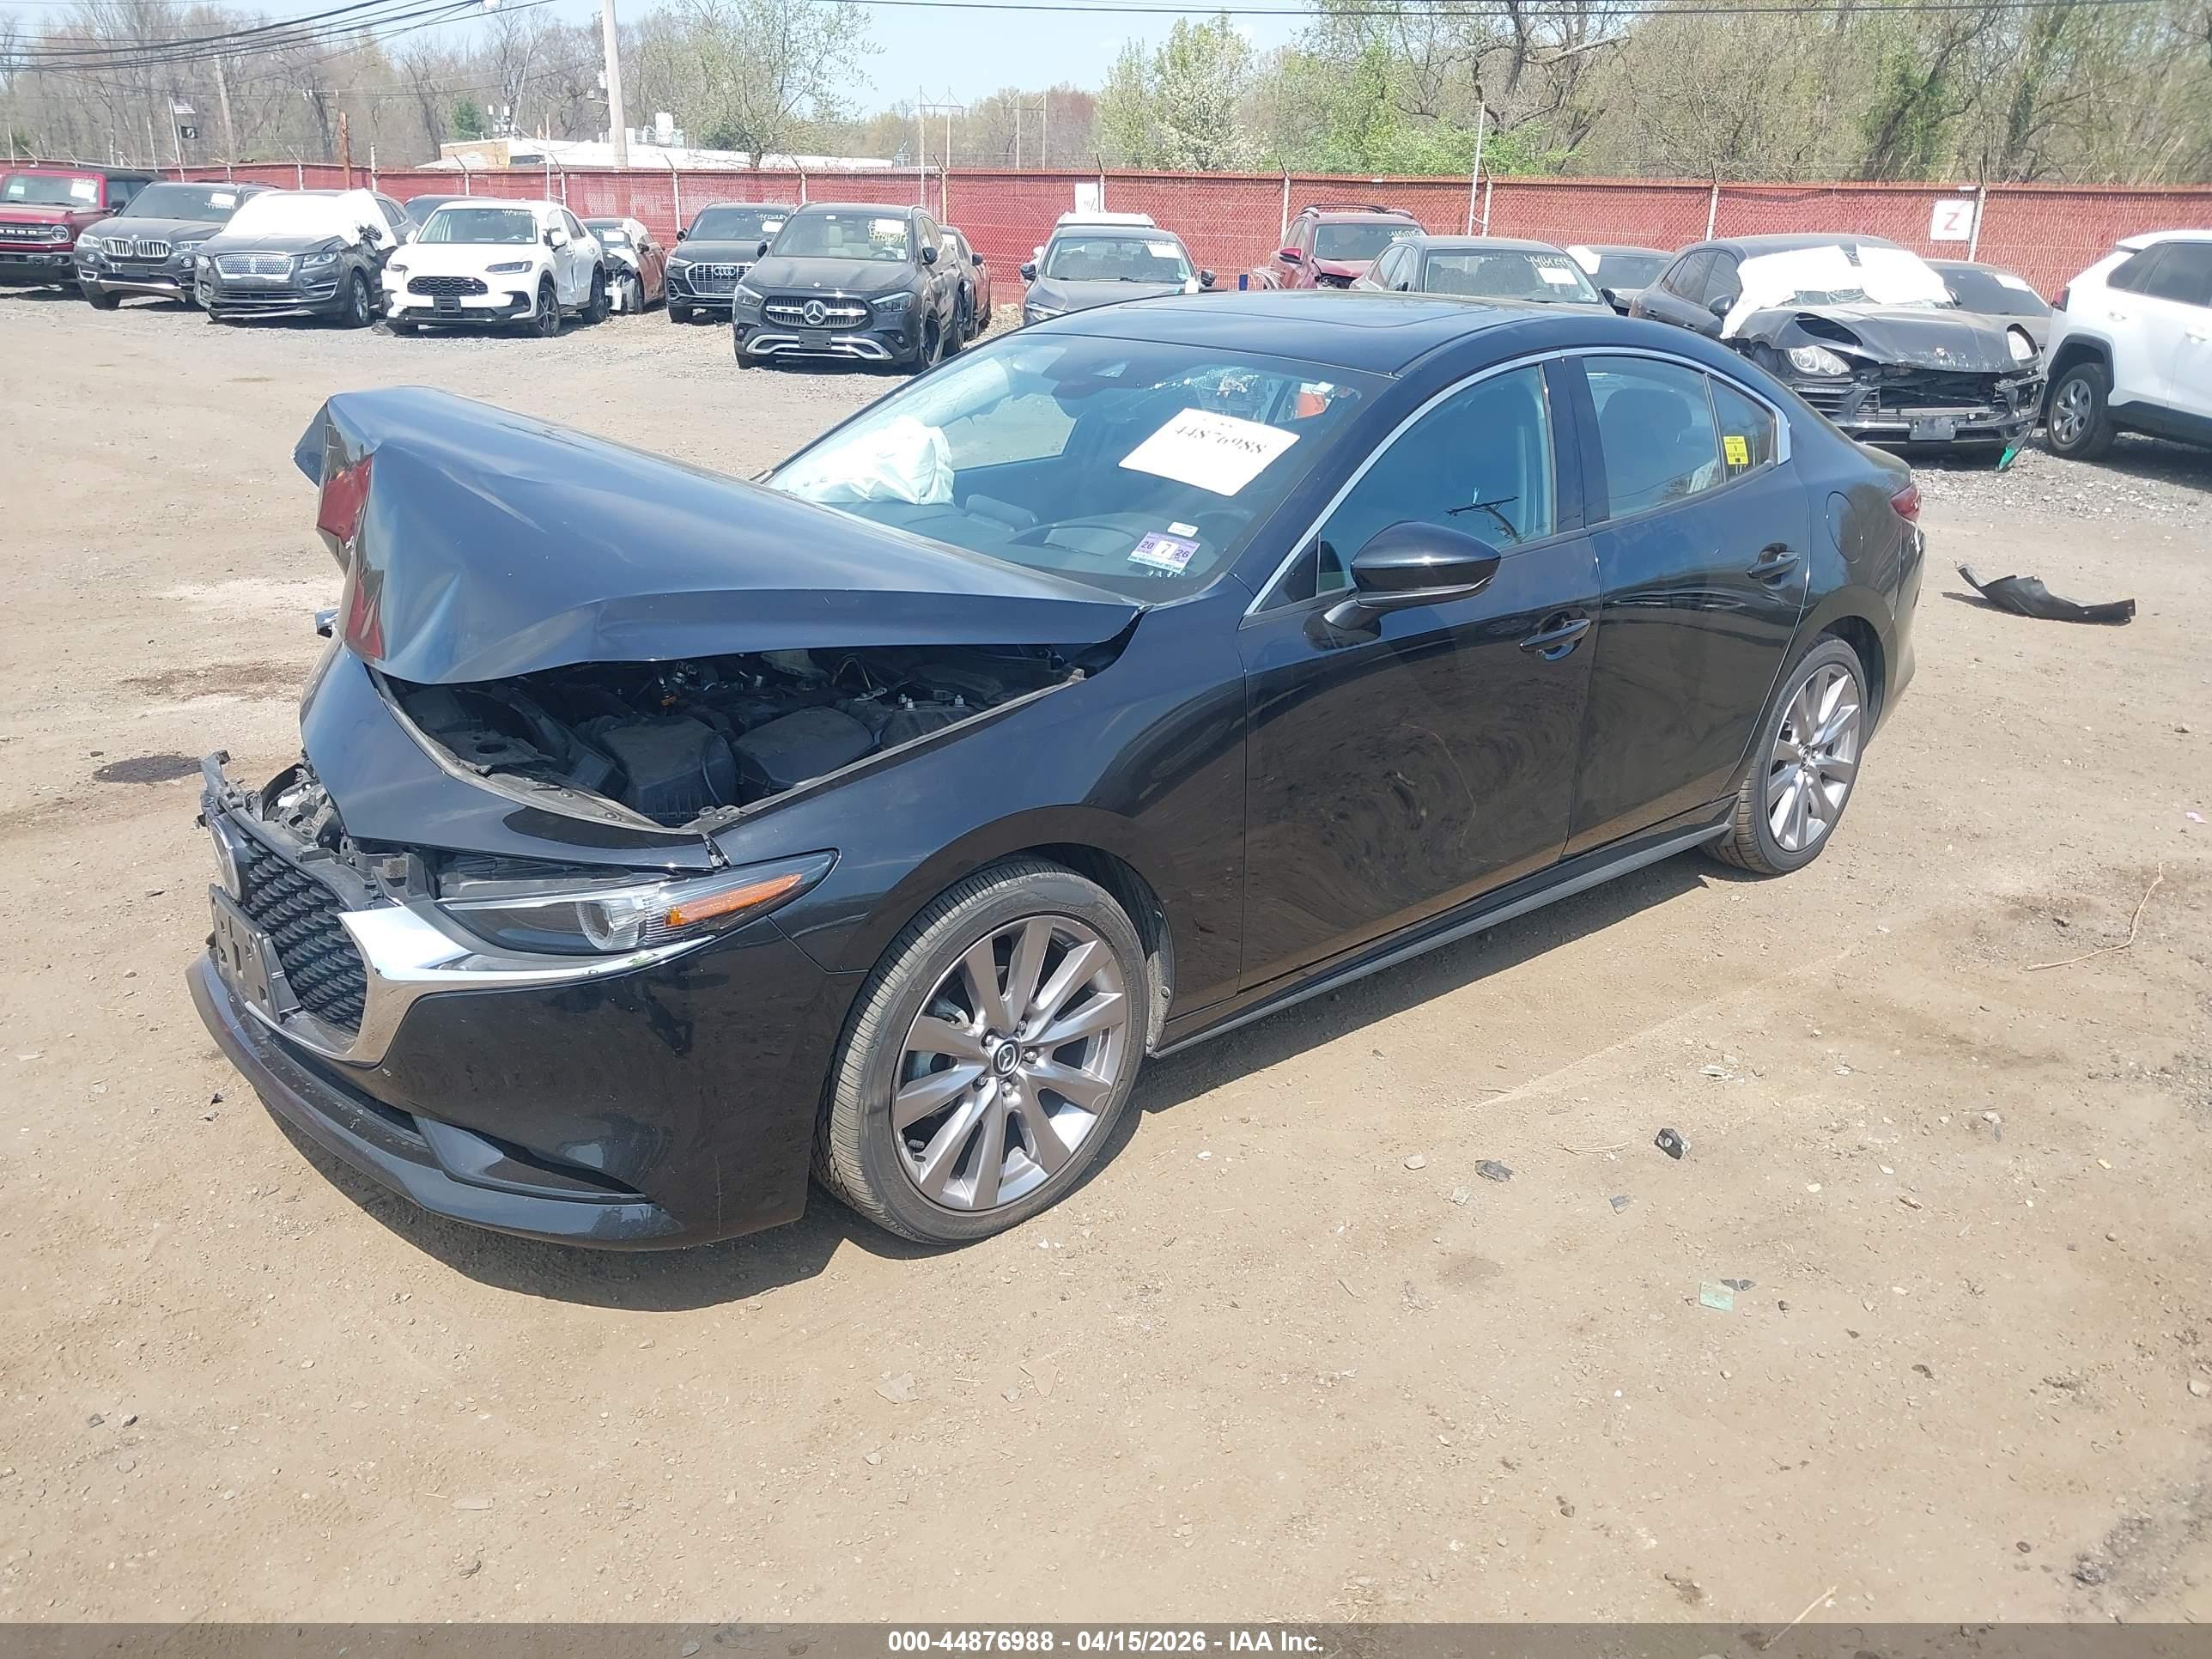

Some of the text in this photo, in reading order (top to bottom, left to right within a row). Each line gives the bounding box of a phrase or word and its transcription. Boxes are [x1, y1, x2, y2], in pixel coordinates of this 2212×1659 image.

[1943, 212, 1960, 231] Z
[1141, 541, 1154, 550] 20
[1161, 543, 1172, 554] 7
[1175, 550, 1190, 558] 26
